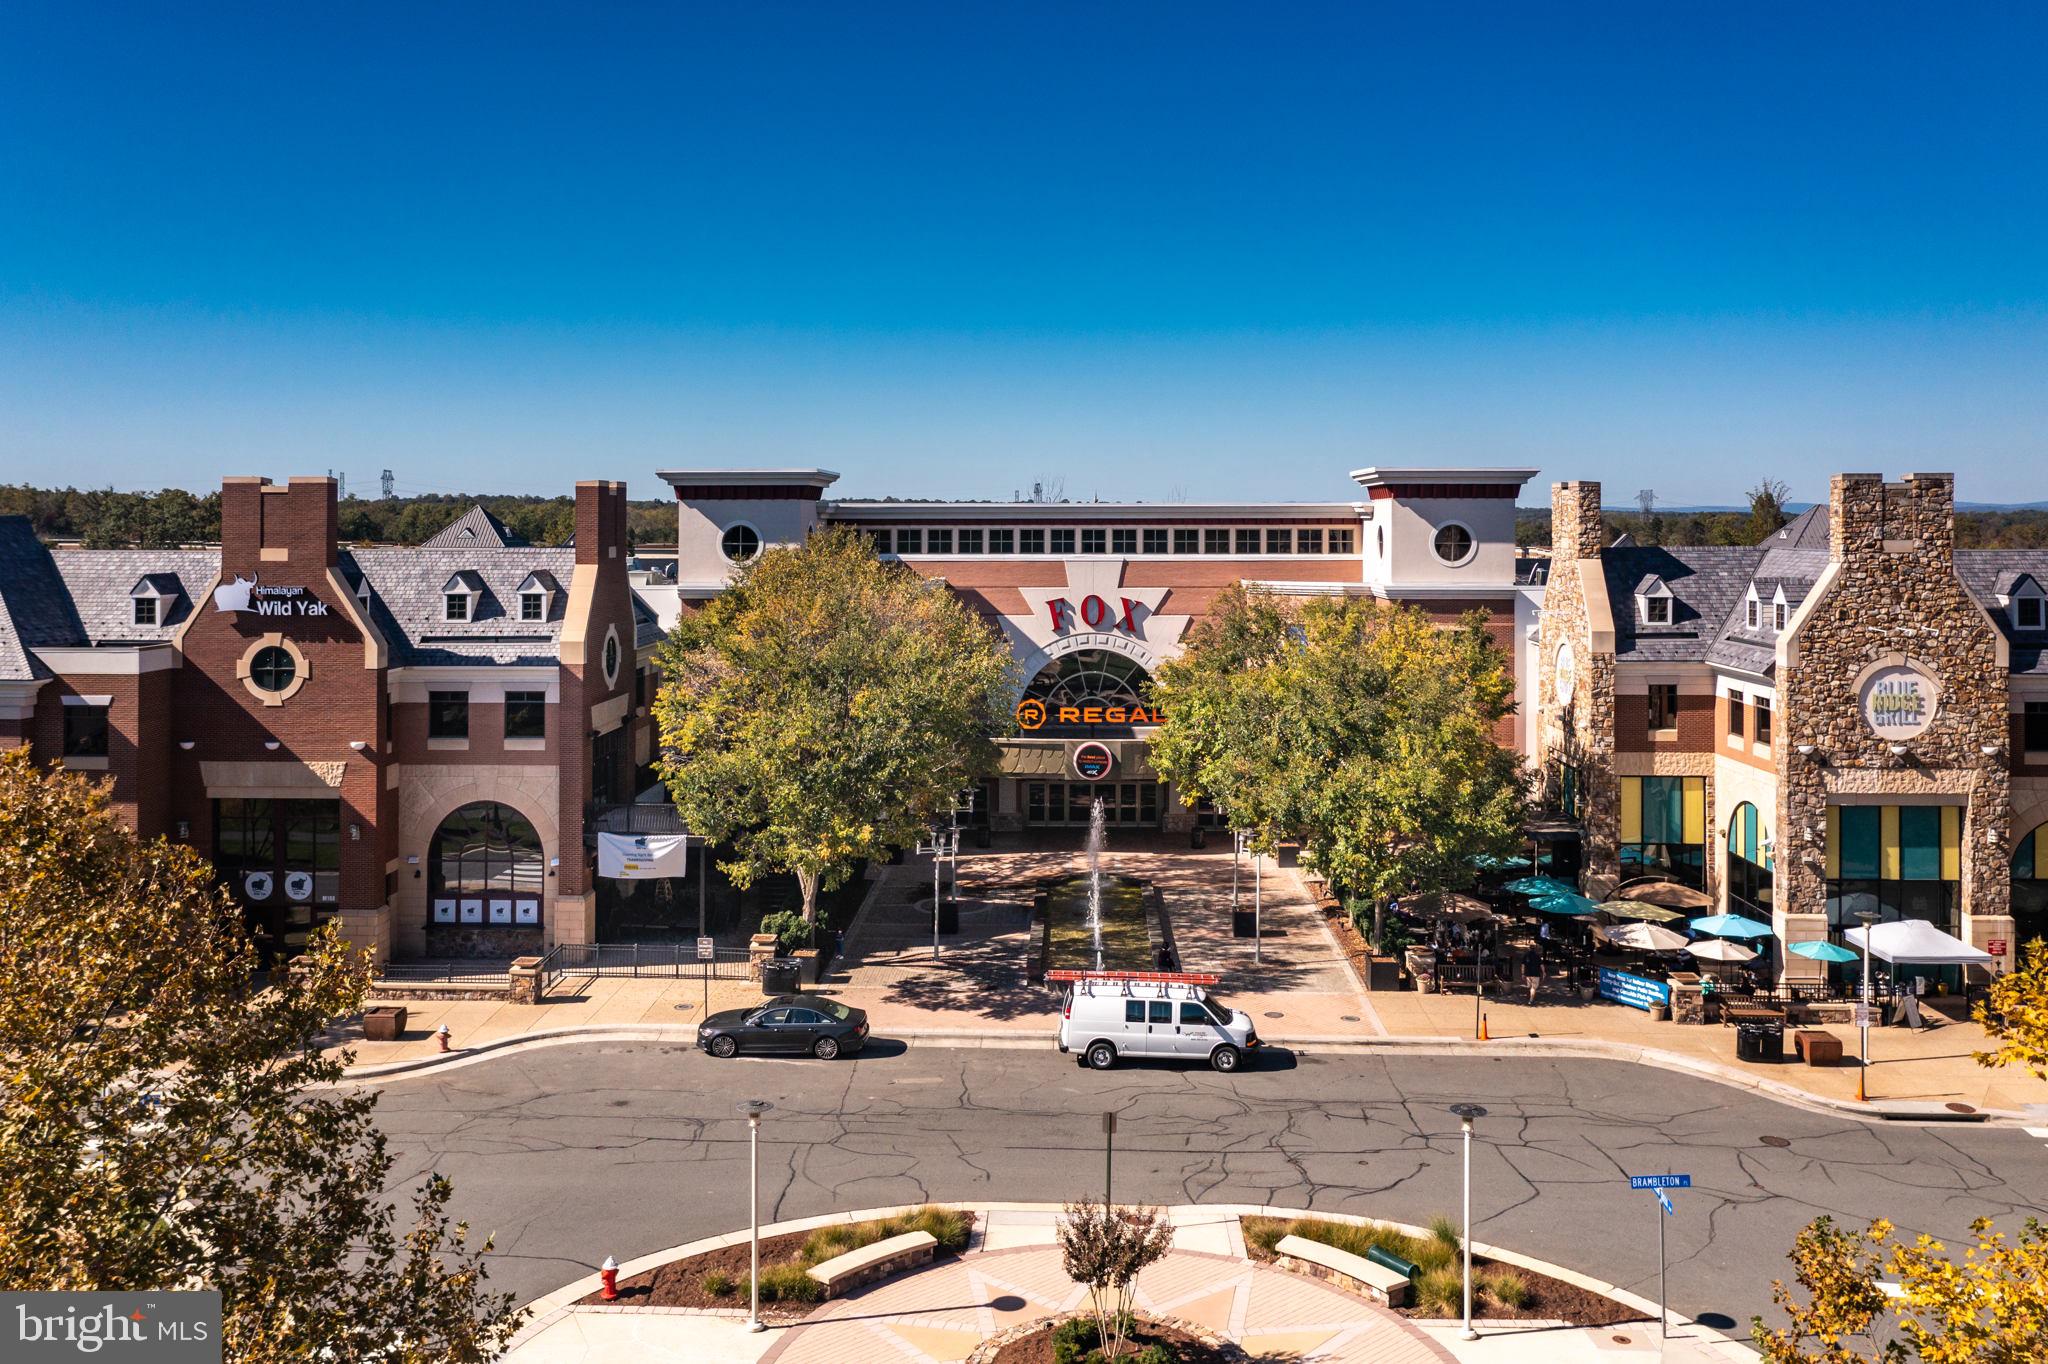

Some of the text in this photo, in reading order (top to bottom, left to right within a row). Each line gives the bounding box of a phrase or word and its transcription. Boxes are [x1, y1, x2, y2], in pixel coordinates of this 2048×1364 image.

[256, 587, 303, 597] Himalayan
[256, 601, 328, 615] Wild Yak
[1045, 595, 1143, 632] FOX
[1876, 680, 1918, 695] BLUE
[1872, 693, 1921, 712] RIDGE
[1059, 707, 1169, 723] REGAL
[1873, 710, 1920, 724] GRILL
[1632, 1177, 1680, 1187] BRAMBLETON
